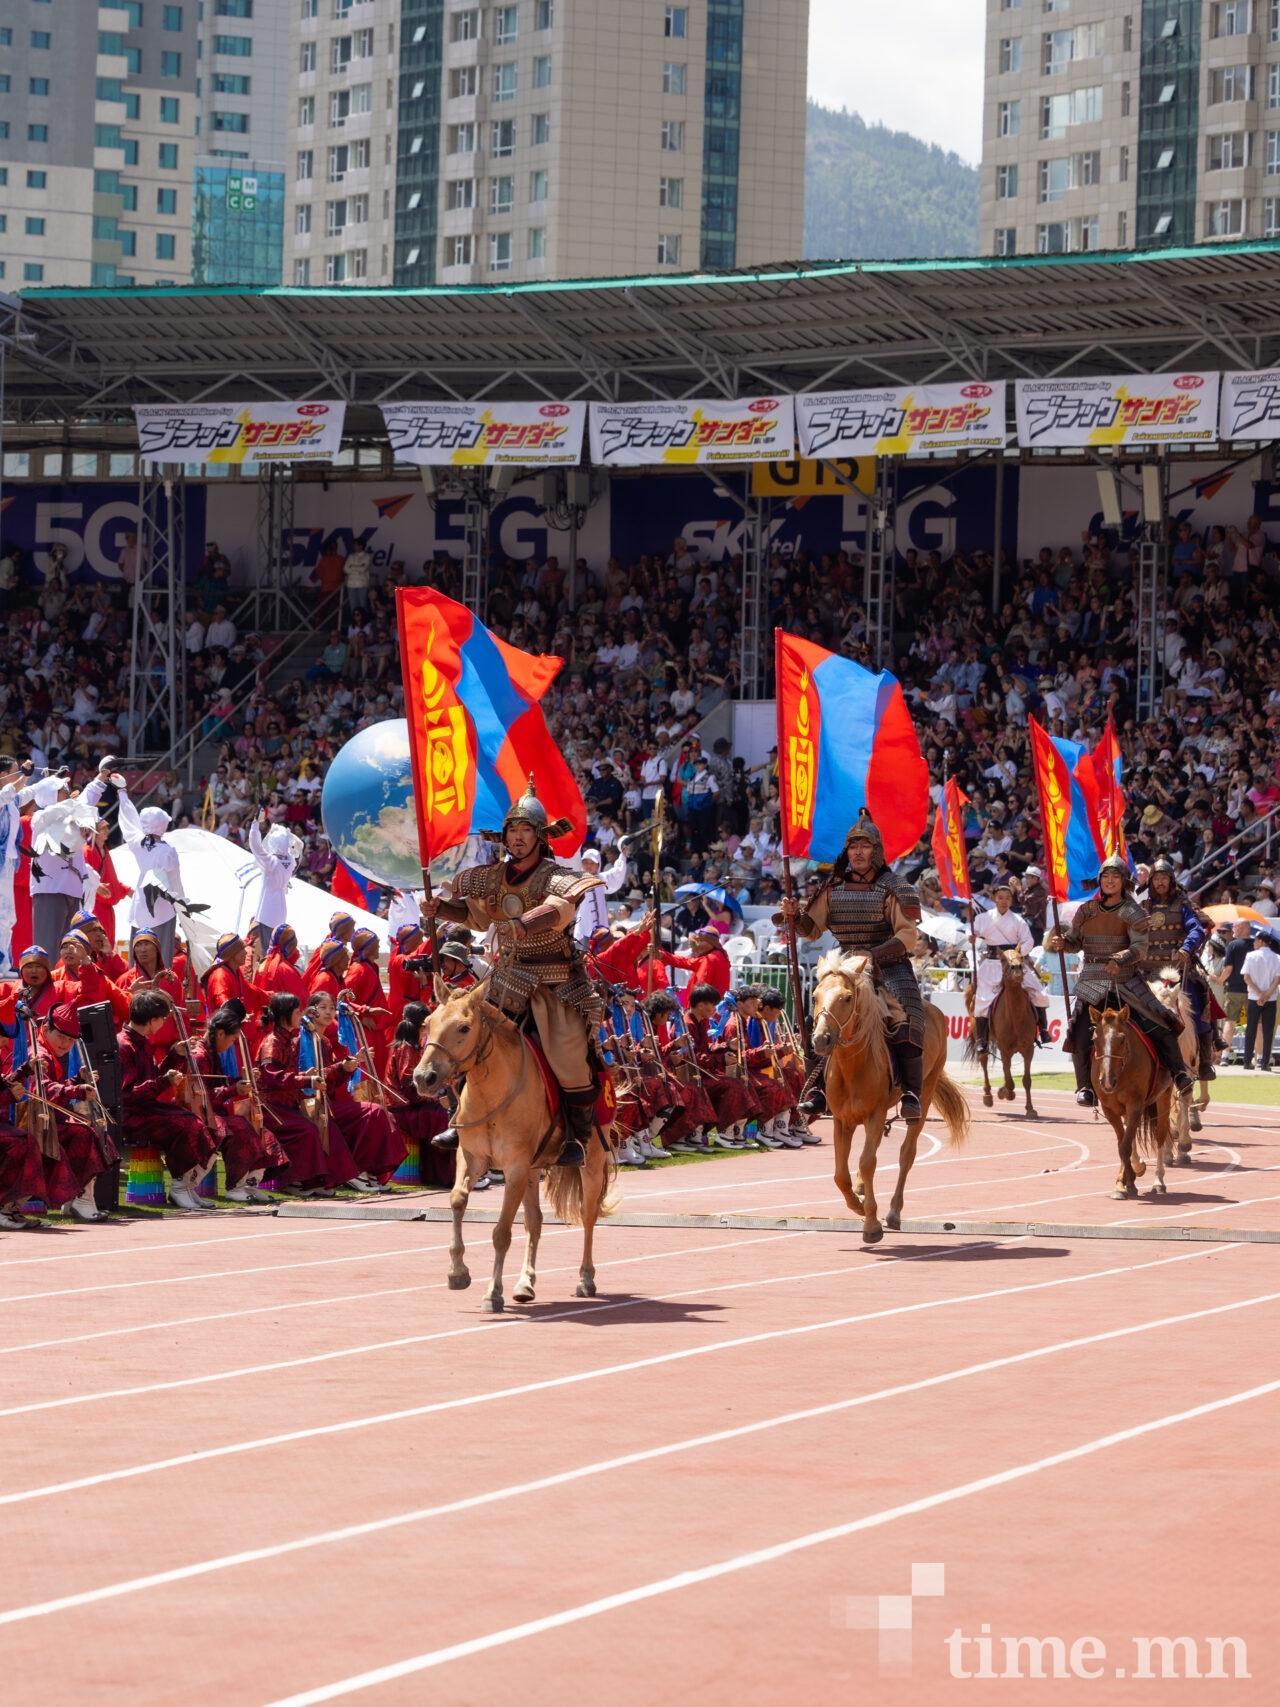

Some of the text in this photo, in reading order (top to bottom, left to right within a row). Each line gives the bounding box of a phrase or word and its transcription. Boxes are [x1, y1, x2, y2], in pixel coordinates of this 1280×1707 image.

[32, 502, 142, 580] 5G
[433, 496, 549, 568] 5G
[840, 485, 957, 566] 5G
